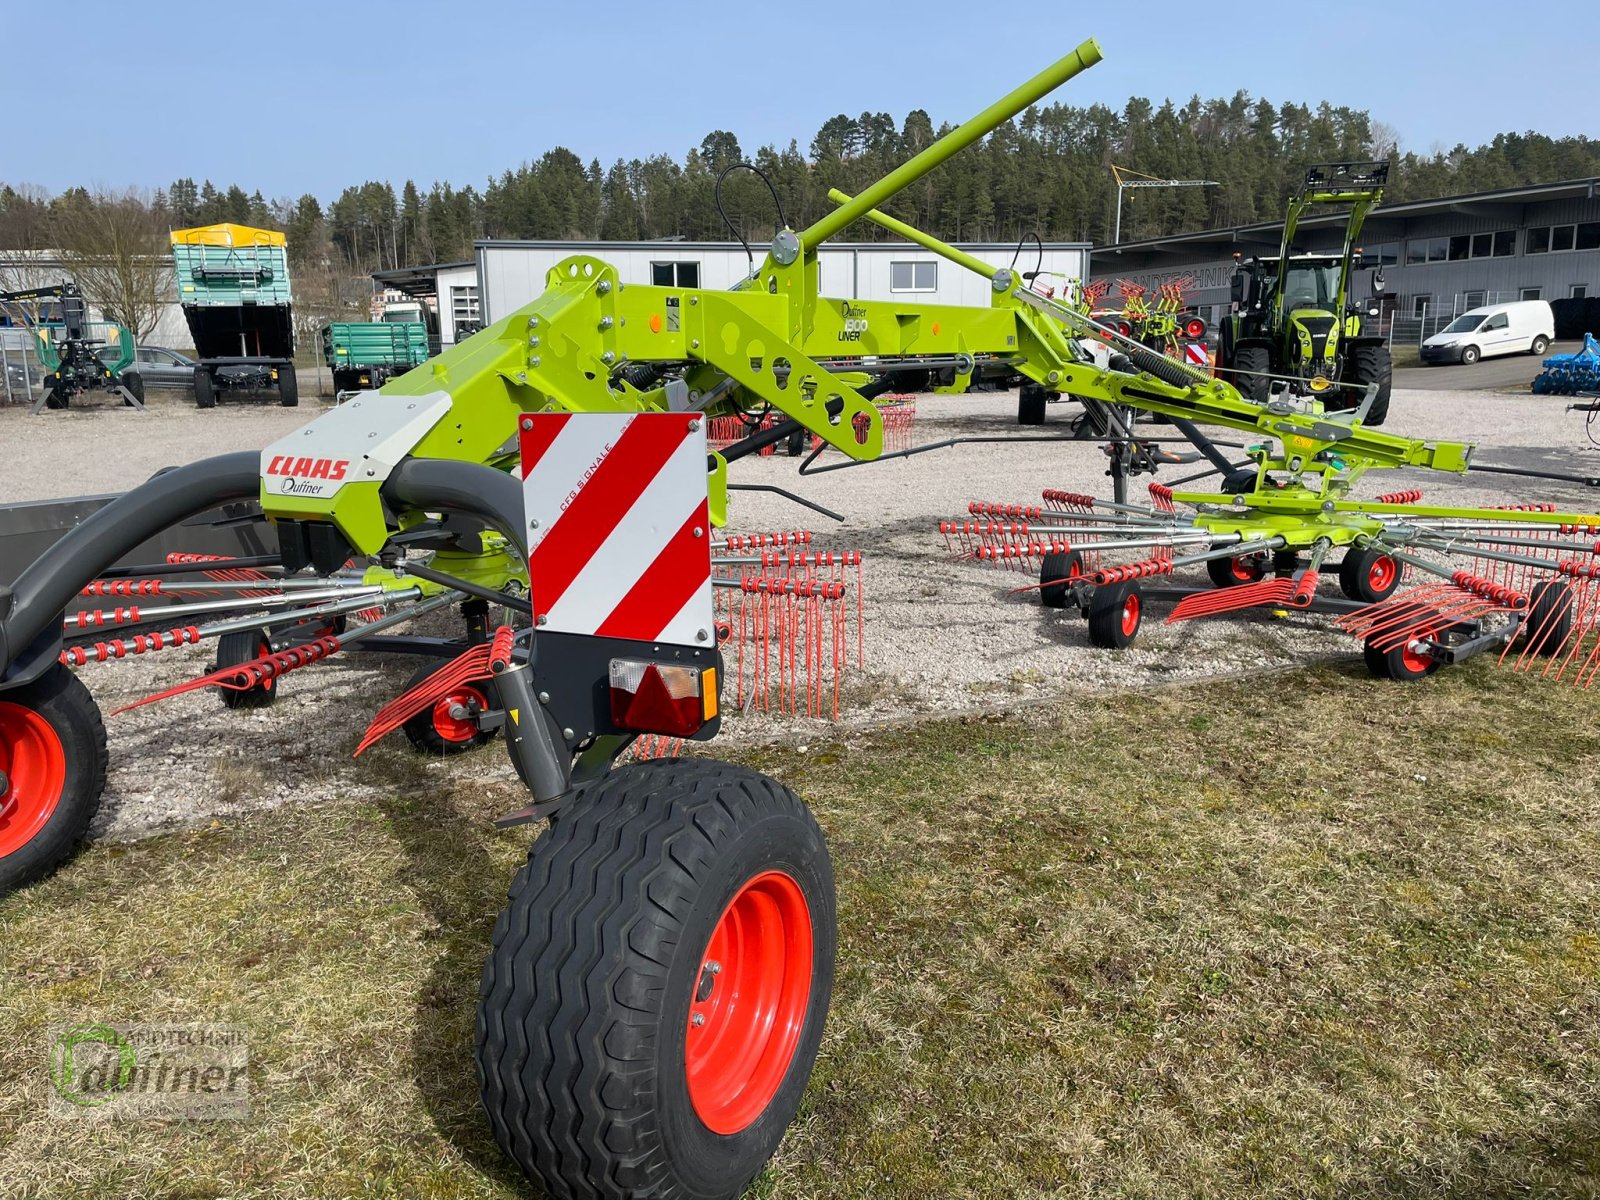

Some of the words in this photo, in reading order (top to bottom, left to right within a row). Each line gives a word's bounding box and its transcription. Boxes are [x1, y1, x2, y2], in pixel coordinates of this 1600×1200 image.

[1122, 266, 1235, 295] ANDTECHNIK
[838, 331, 860, 342] LINER
[266, 455, 350, 481] CLAAS
[560, 490, 577, 512] CFG
[576, 443, 613, 490] SIGNALE
[281, 477, 323, 494] Duffner
